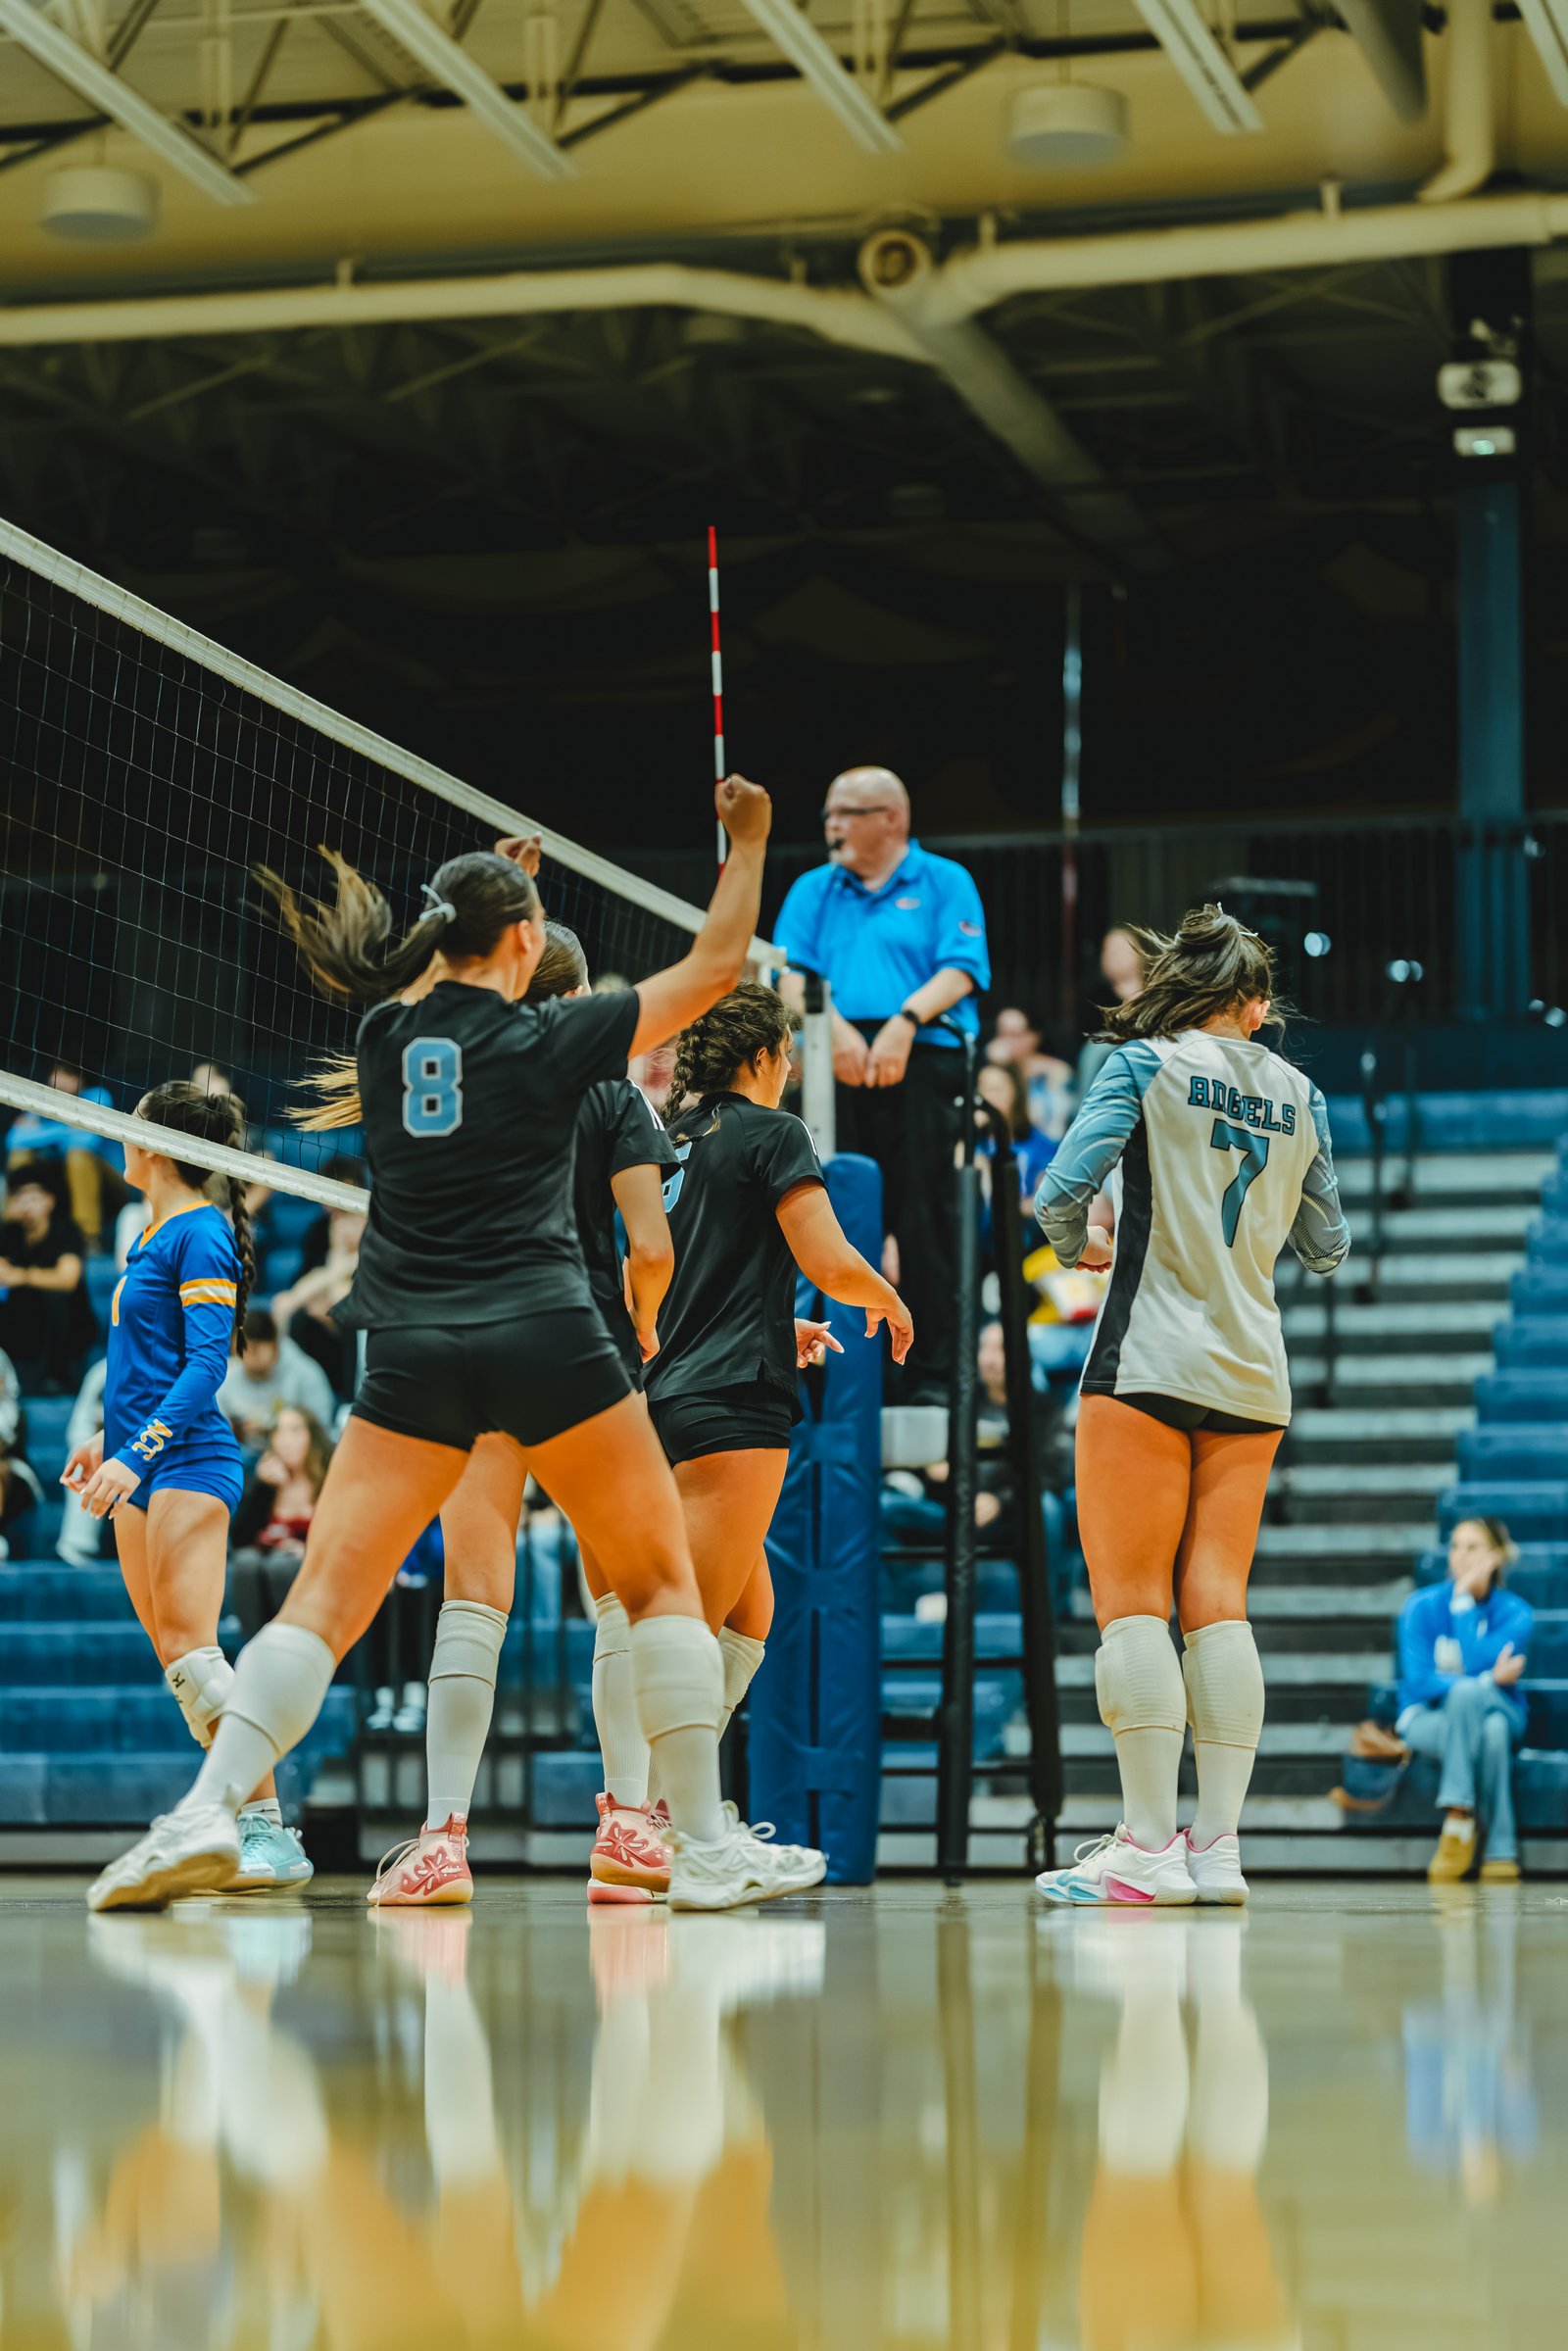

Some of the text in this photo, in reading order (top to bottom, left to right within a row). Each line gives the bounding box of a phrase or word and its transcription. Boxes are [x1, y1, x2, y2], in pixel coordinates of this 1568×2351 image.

[402, 1037, 463, 1138] 8
[1188, 1076, 1296, 1136] ANGELS
[1210, 1118, 1269, 1248] 7
